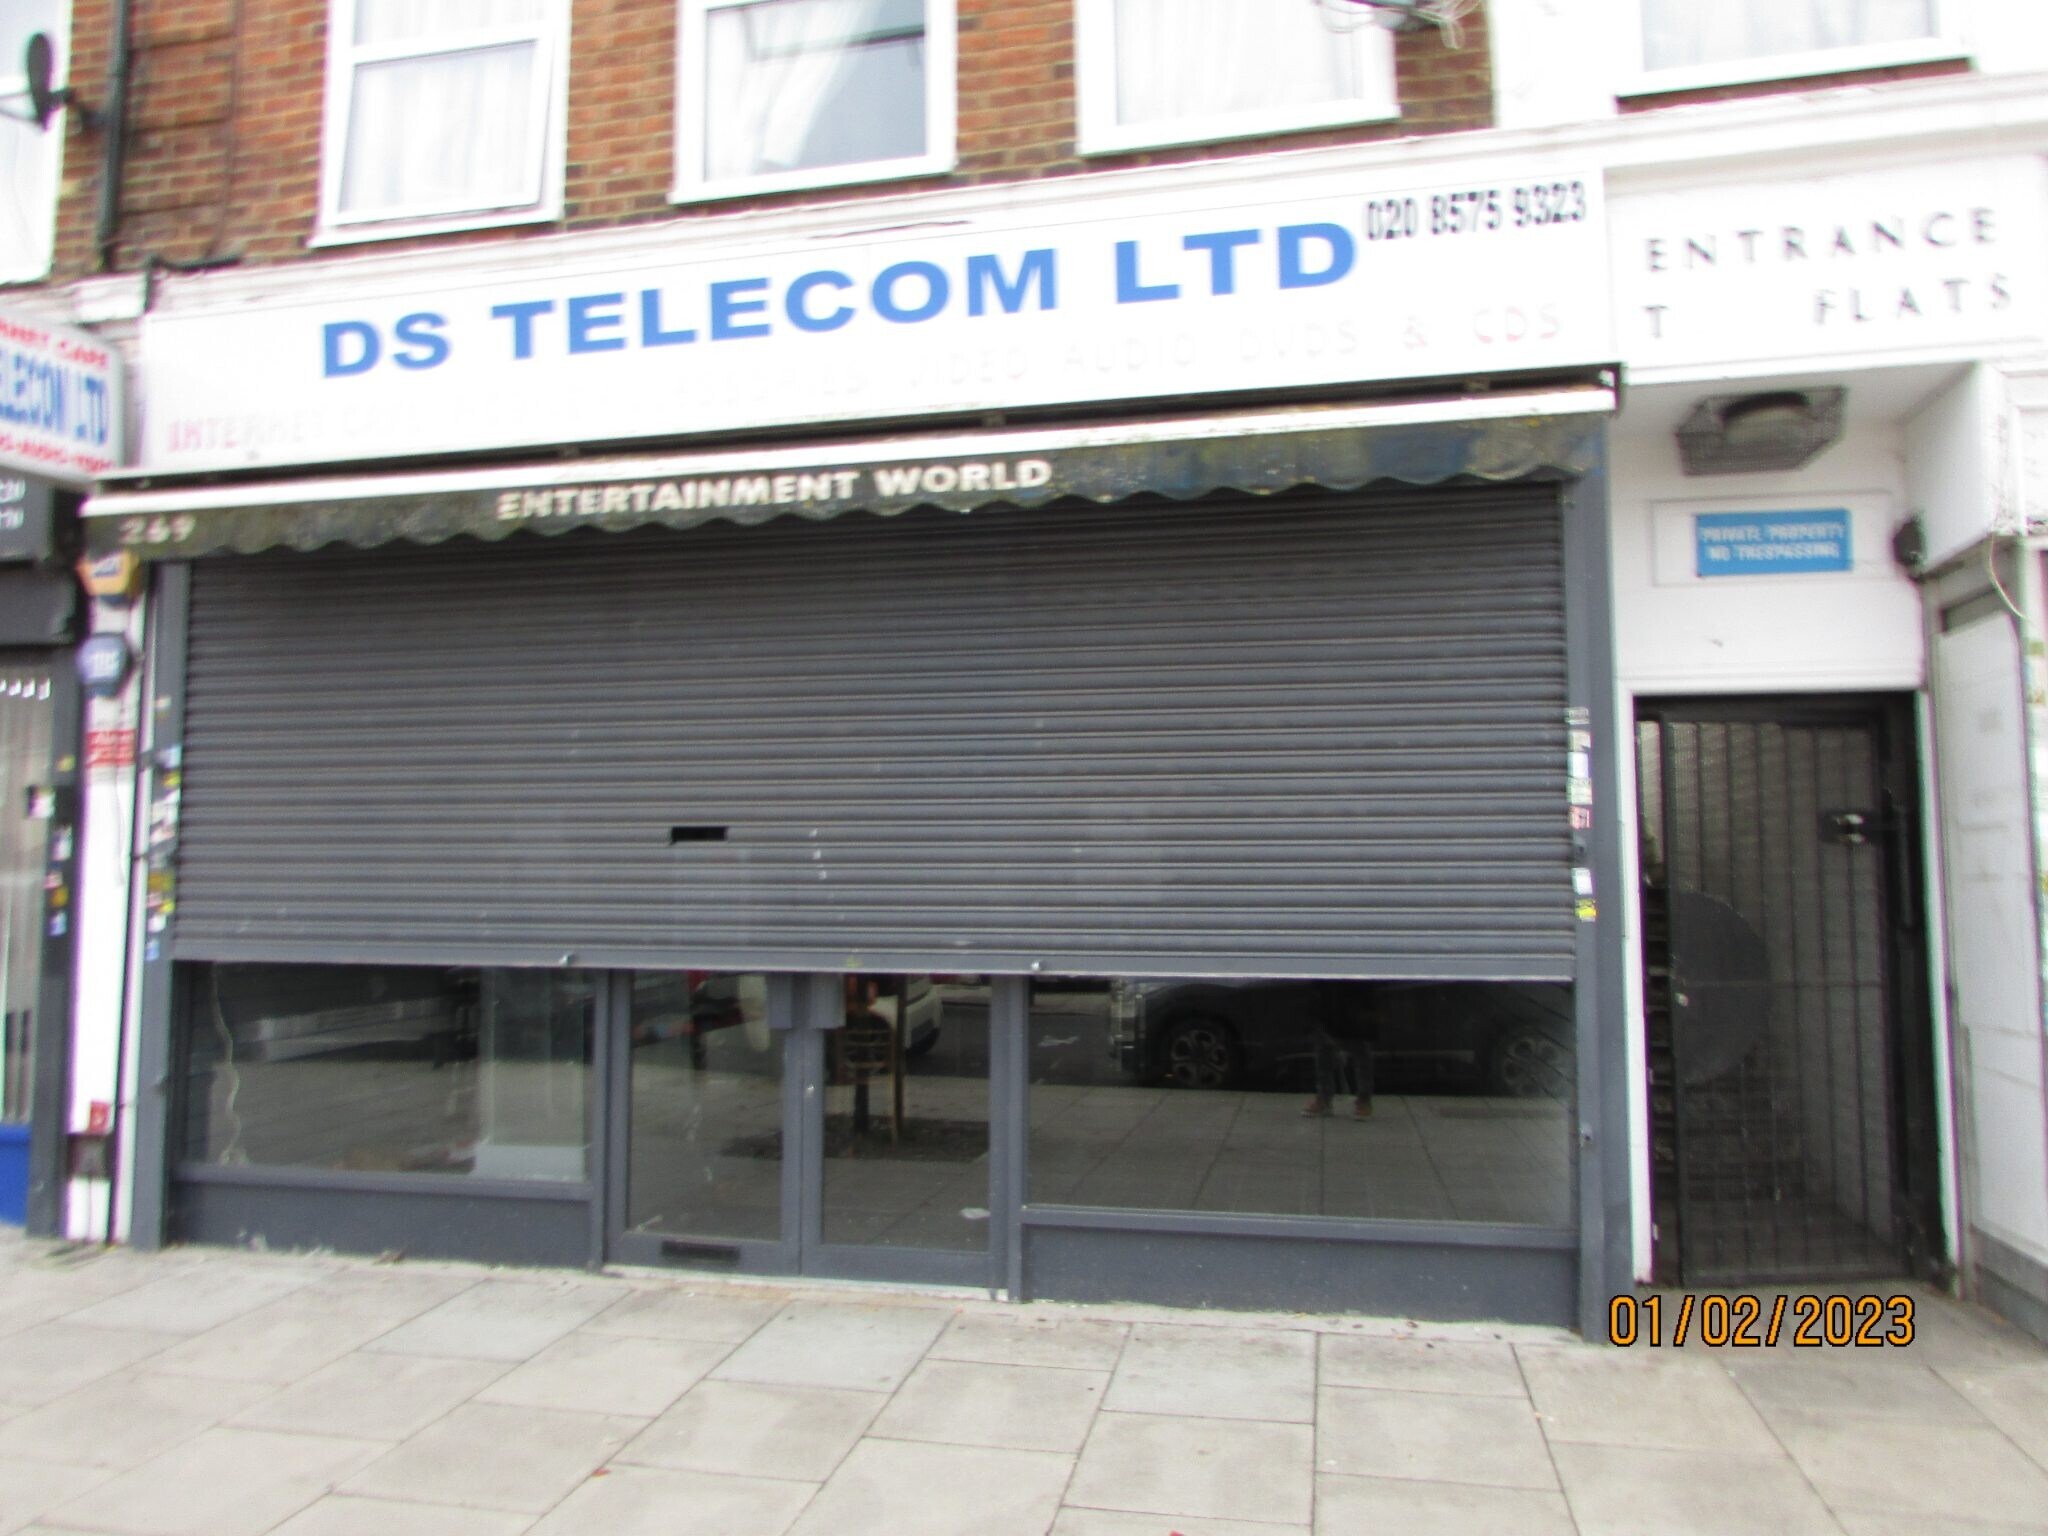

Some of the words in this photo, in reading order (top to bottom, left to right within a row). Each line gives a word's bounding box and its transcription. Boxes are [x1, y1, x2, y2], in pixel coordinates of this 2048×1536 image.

[1366, 197, 1418, 241] 020
[1430, 189, 1502, 235] 8575
[1511, 181, 1588, 227] 9323
[1644, 206, 1997, 272] ENTRANCE
[321, 311, 449, 377] DS
[491, 247, 1057, 359] TELECOM
[1114, 222, 1357, 303] LTD
[1813, 273, 2011, 326] FLATS
[499, 471, 859, 521] ENTERTAINMENT
[873, 460, 1052, 495] WORLD
[119, 513, 197, 544] 269
